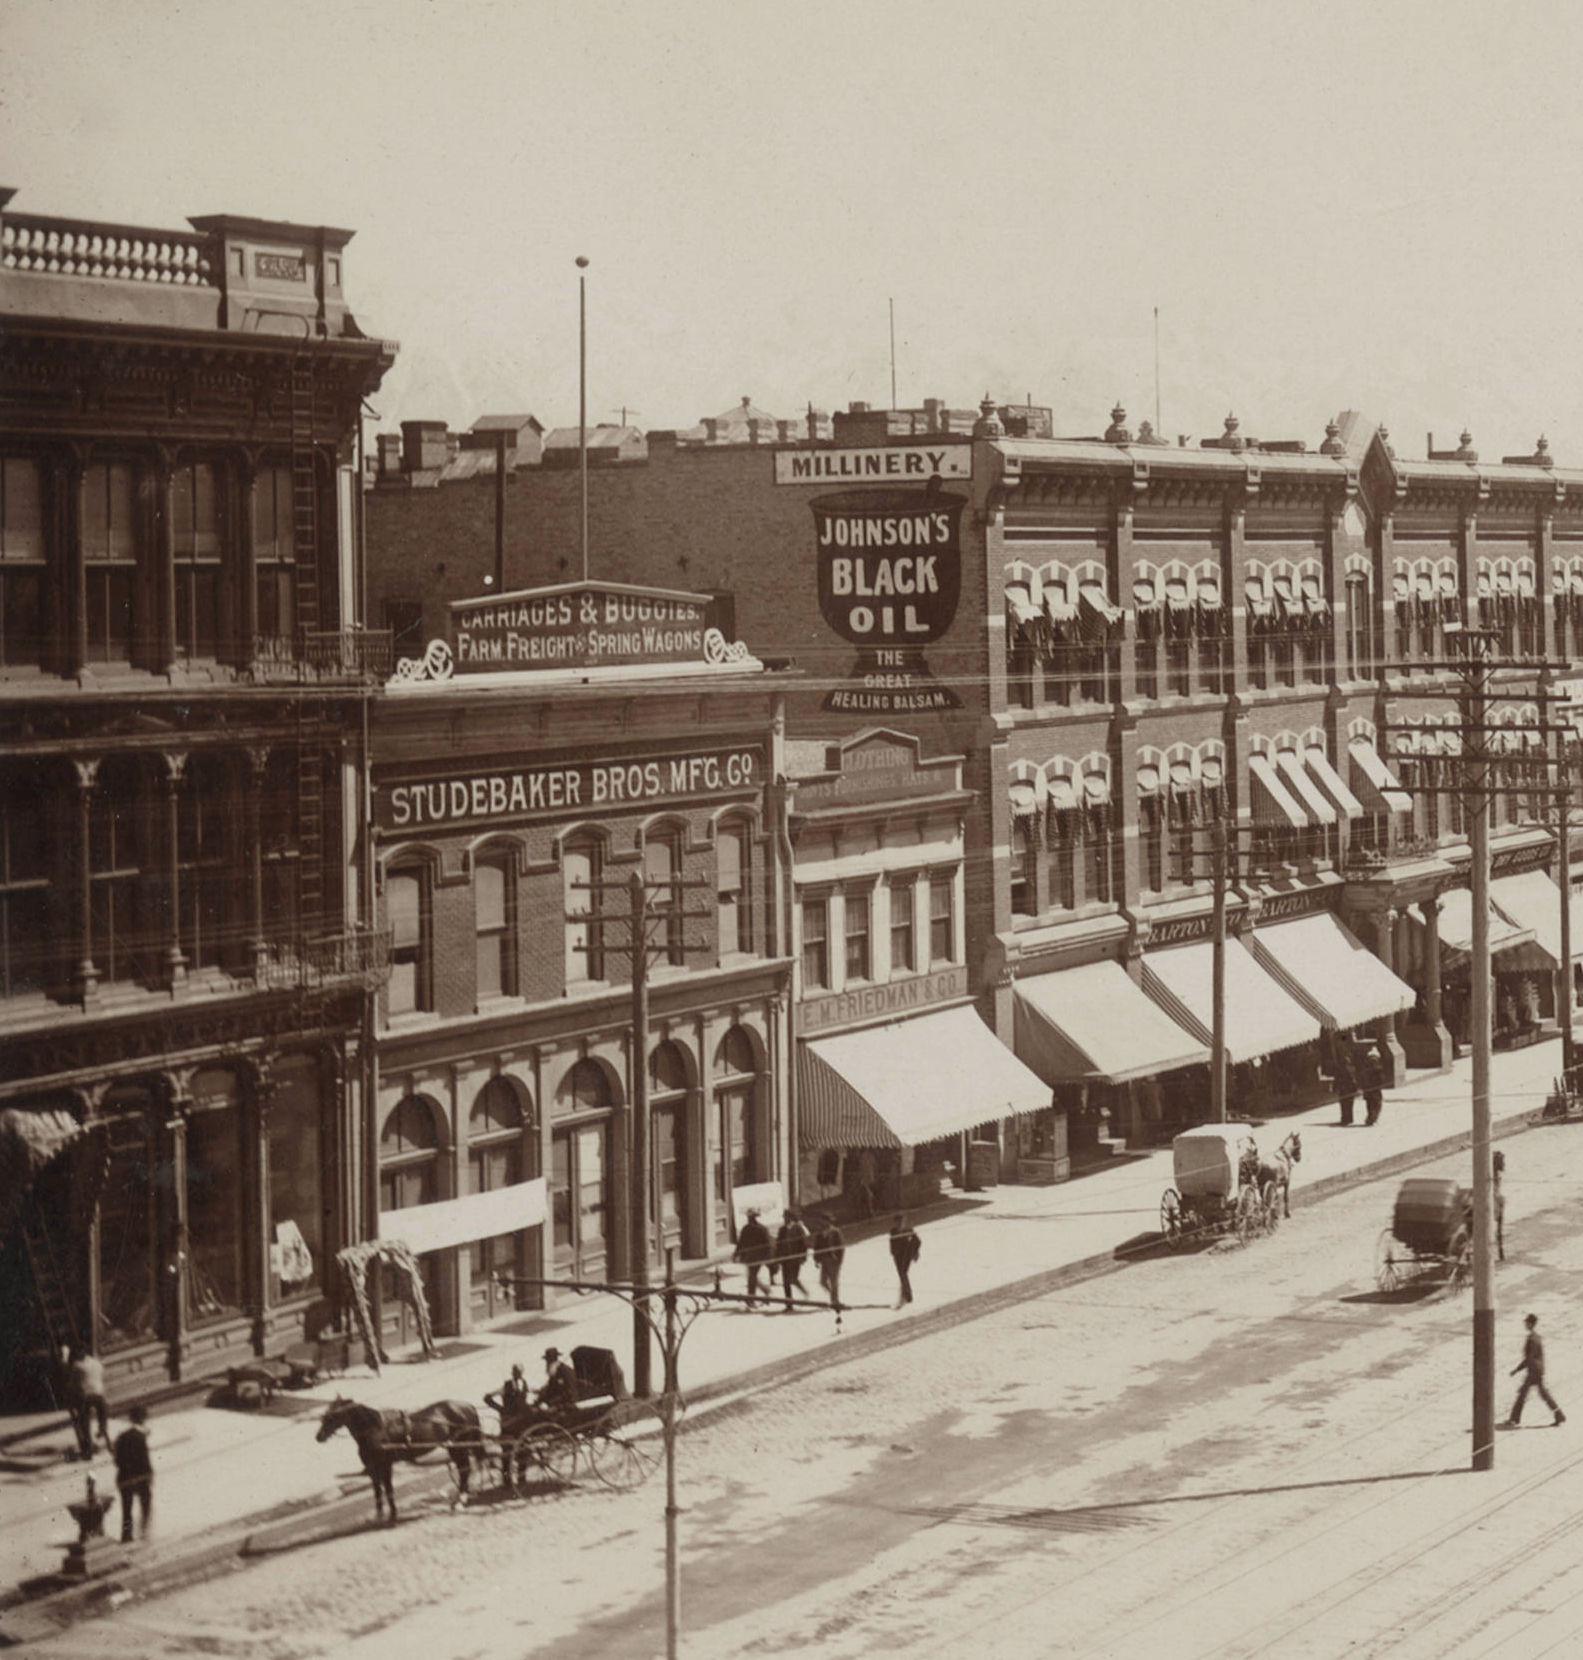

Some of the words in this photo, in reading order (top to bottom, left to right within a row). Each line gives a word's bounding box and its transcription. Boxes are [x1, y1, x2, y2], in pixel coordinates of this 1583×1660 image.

[792, 452, 957, 477] MILLINERY.
[820, 513, 950, 547] JOHNSON'S
[831, 556, 939, 596] BLACK
[461, 596, 572, 629] CARRIAGES
[580, 592, 598, 625] &
[850, 605, 930, 634] OIL
[506, 631, 577, 660] FREIGHT
[588, 630, 641, 656] SPRING
[641, 627, 701, 652] WAGONS
[875, 650, 904, 666] THE
[864, 674, 912, 689] GREAT
[831, 691, 889, 709] HEALING
[391, 770, 581, 824] STUDEBAKER
[592, 763, 666, 802] BROS.
[1253, 893, 1311, 919] BARTON
[1148, 917, 1208, 946] BARTON
[924, 979, 934, 998] &
